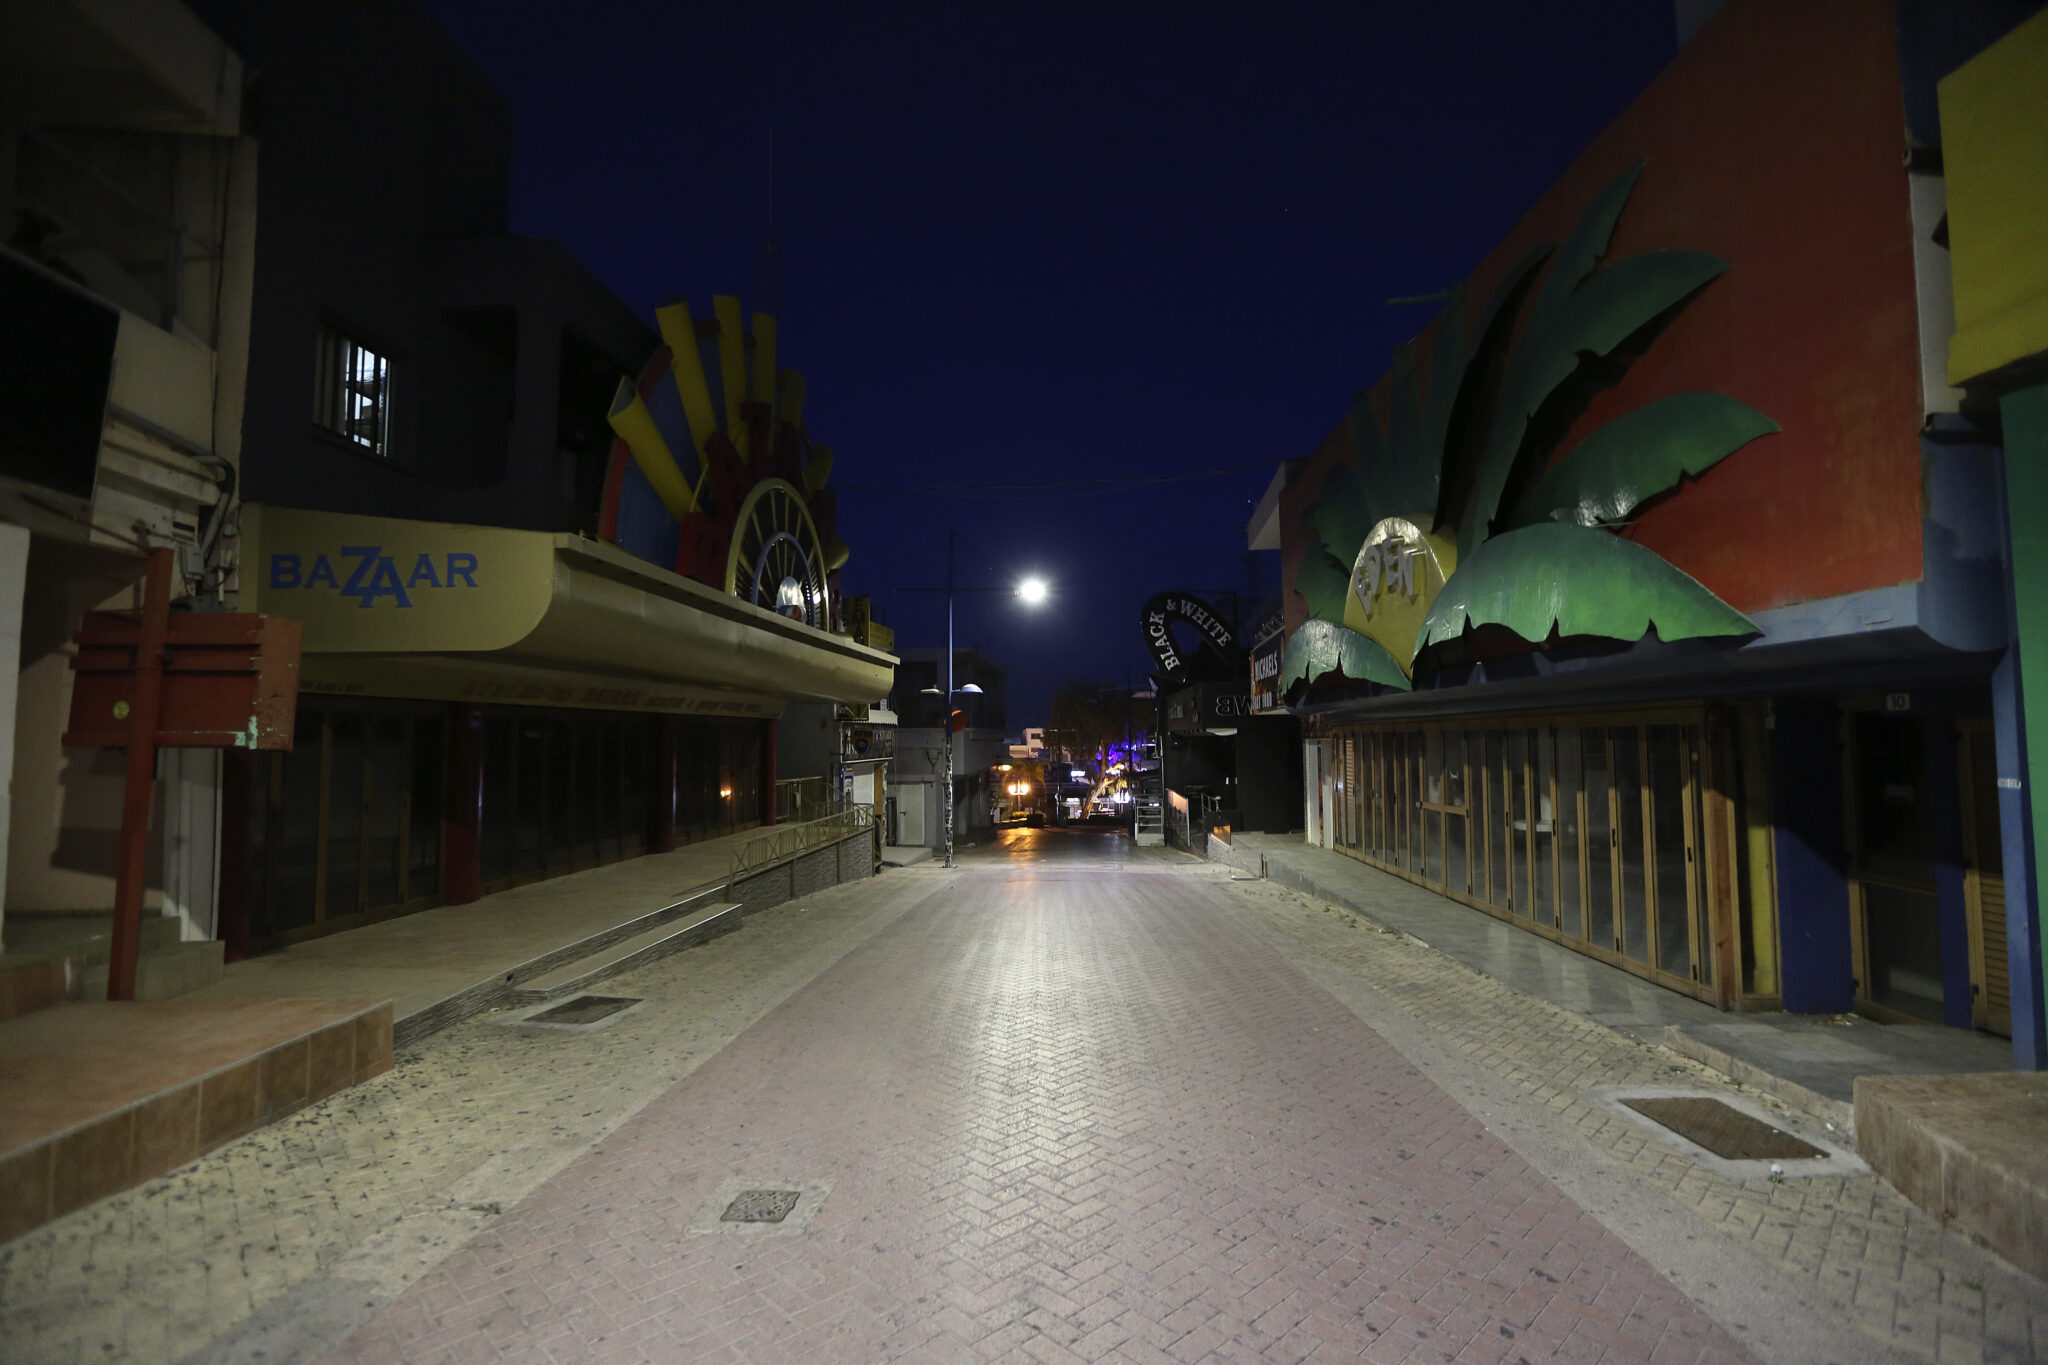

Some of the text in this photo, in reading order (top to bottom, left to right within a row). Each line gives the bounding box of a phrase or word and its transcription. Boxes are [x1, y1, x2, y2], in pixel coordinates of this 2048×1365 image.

[270, 545, 478, 608] BAZAAR
[1149, 610, 1181, 671] BLACK
[1166, 598, 1177, 611] &
[1180, 599, 1233, 647] WHITE
[1254, 649, 1278, 681] MICHAELS
[1891, 695, 1906, 709] 10
